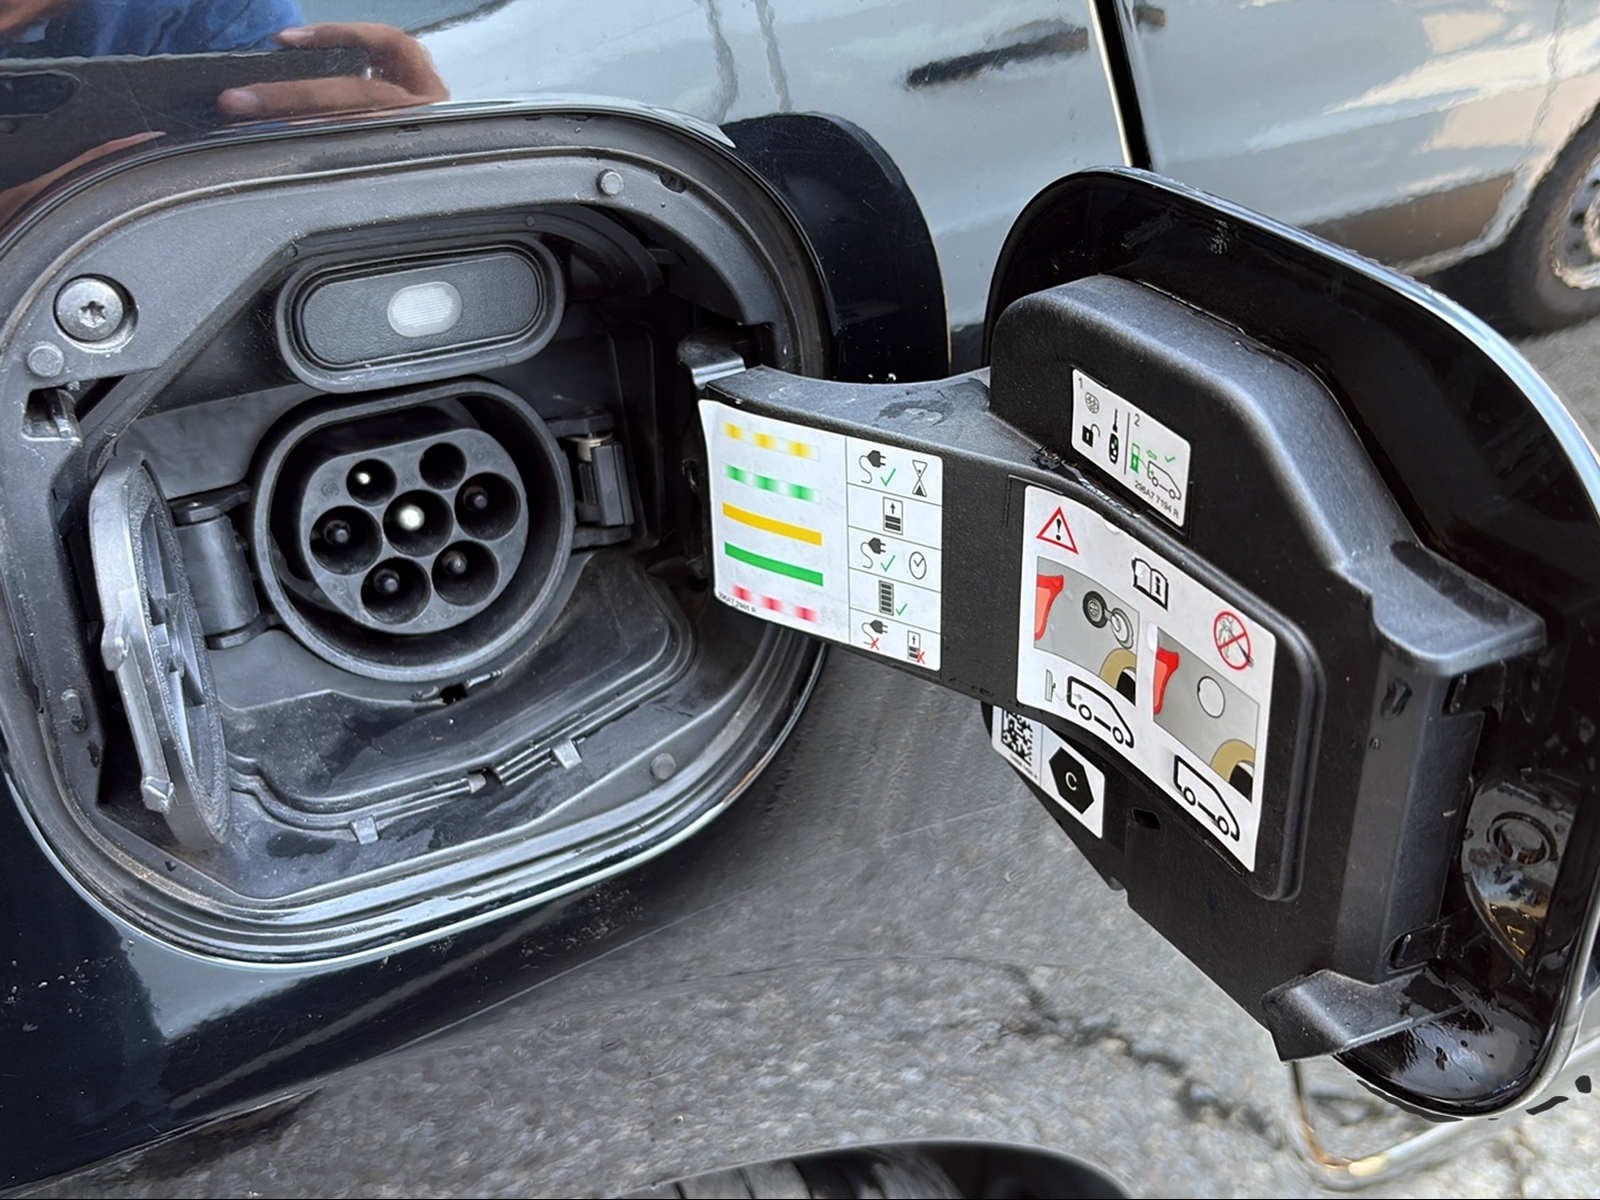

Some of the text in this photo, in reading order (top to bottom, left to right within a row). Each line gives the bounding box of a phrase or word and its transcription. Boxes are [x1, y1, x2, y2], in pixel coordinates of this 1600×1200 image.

[1078, 377, 1083, 389] 1
[1134, 412, 1141, 427] 2
[1065, 771, 1077, 791] C
